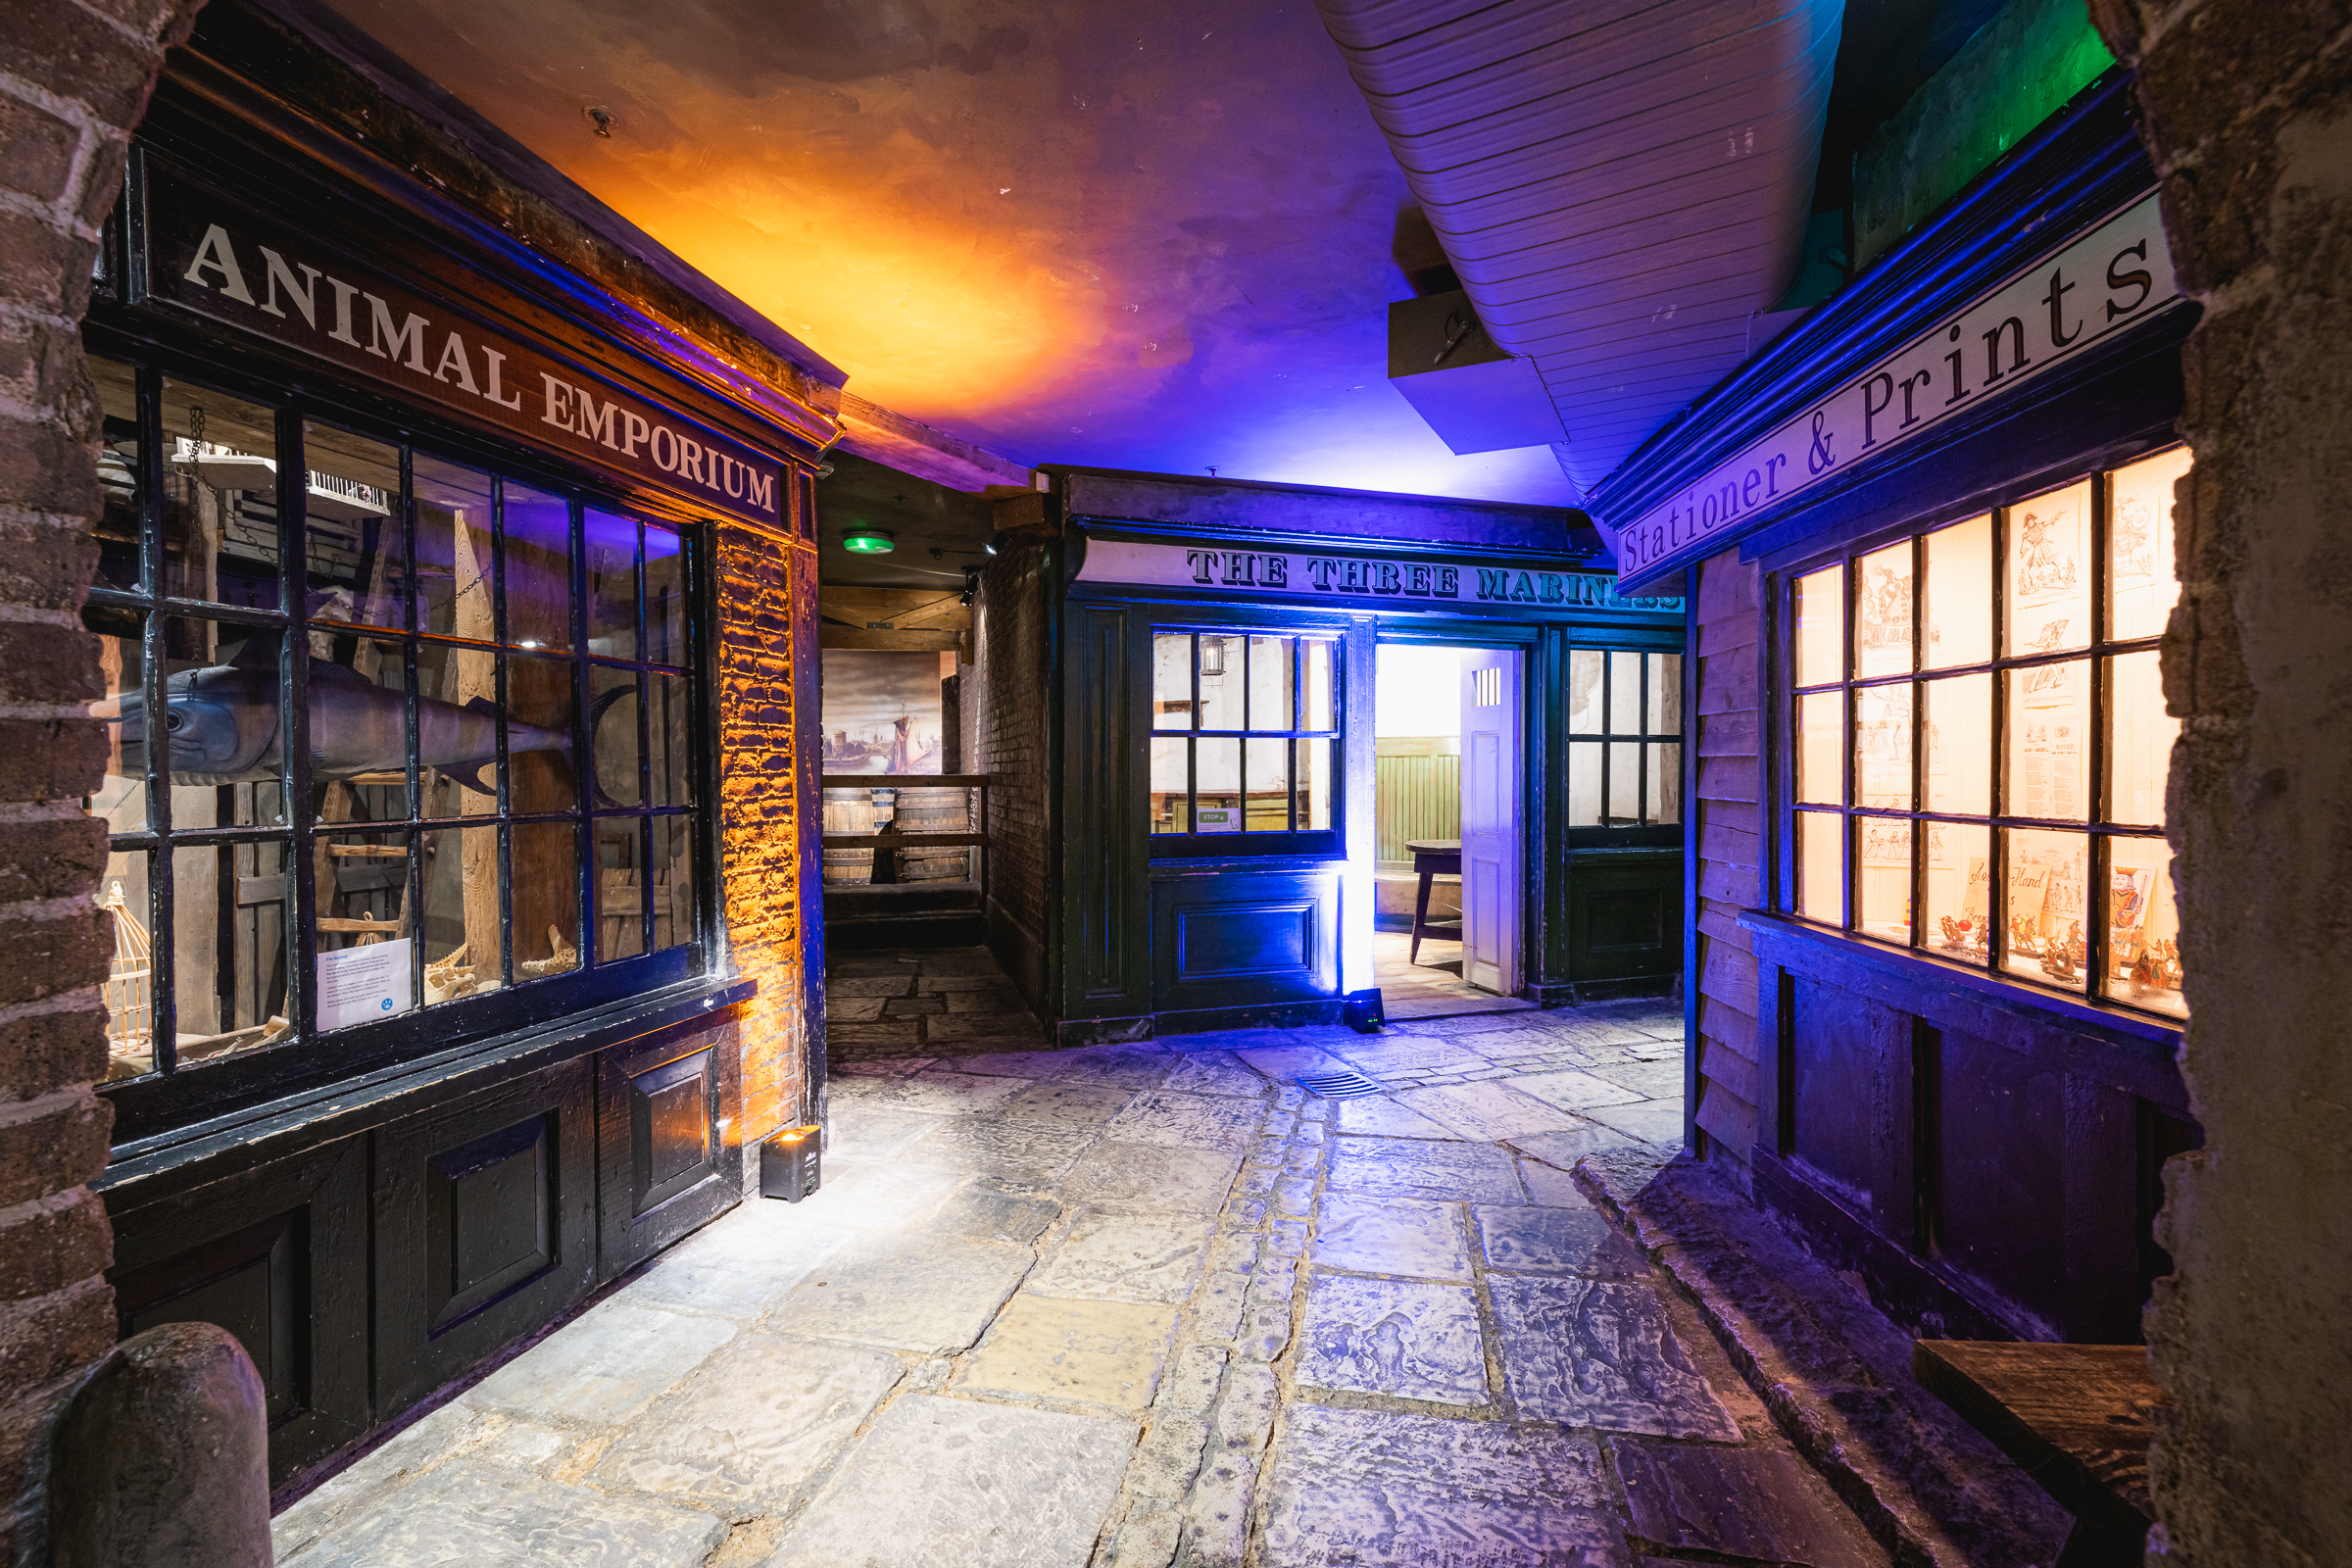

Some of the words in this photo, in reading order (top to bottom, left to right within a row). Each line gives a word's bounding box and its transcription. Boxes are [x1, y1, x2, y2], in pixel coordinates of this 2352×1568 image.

[183, 222, 521, 412] ANIMAL
[540, 371, 775, 514] EMPORIUM
[1623, 451, 1787, 574] Stationer
[1808, 410, 1836, 475] &
[1861, 238, 2153, 450] Prints
[1186, 550, 1288, 590] THE
[1306, 557, 1459, 598] THREE
